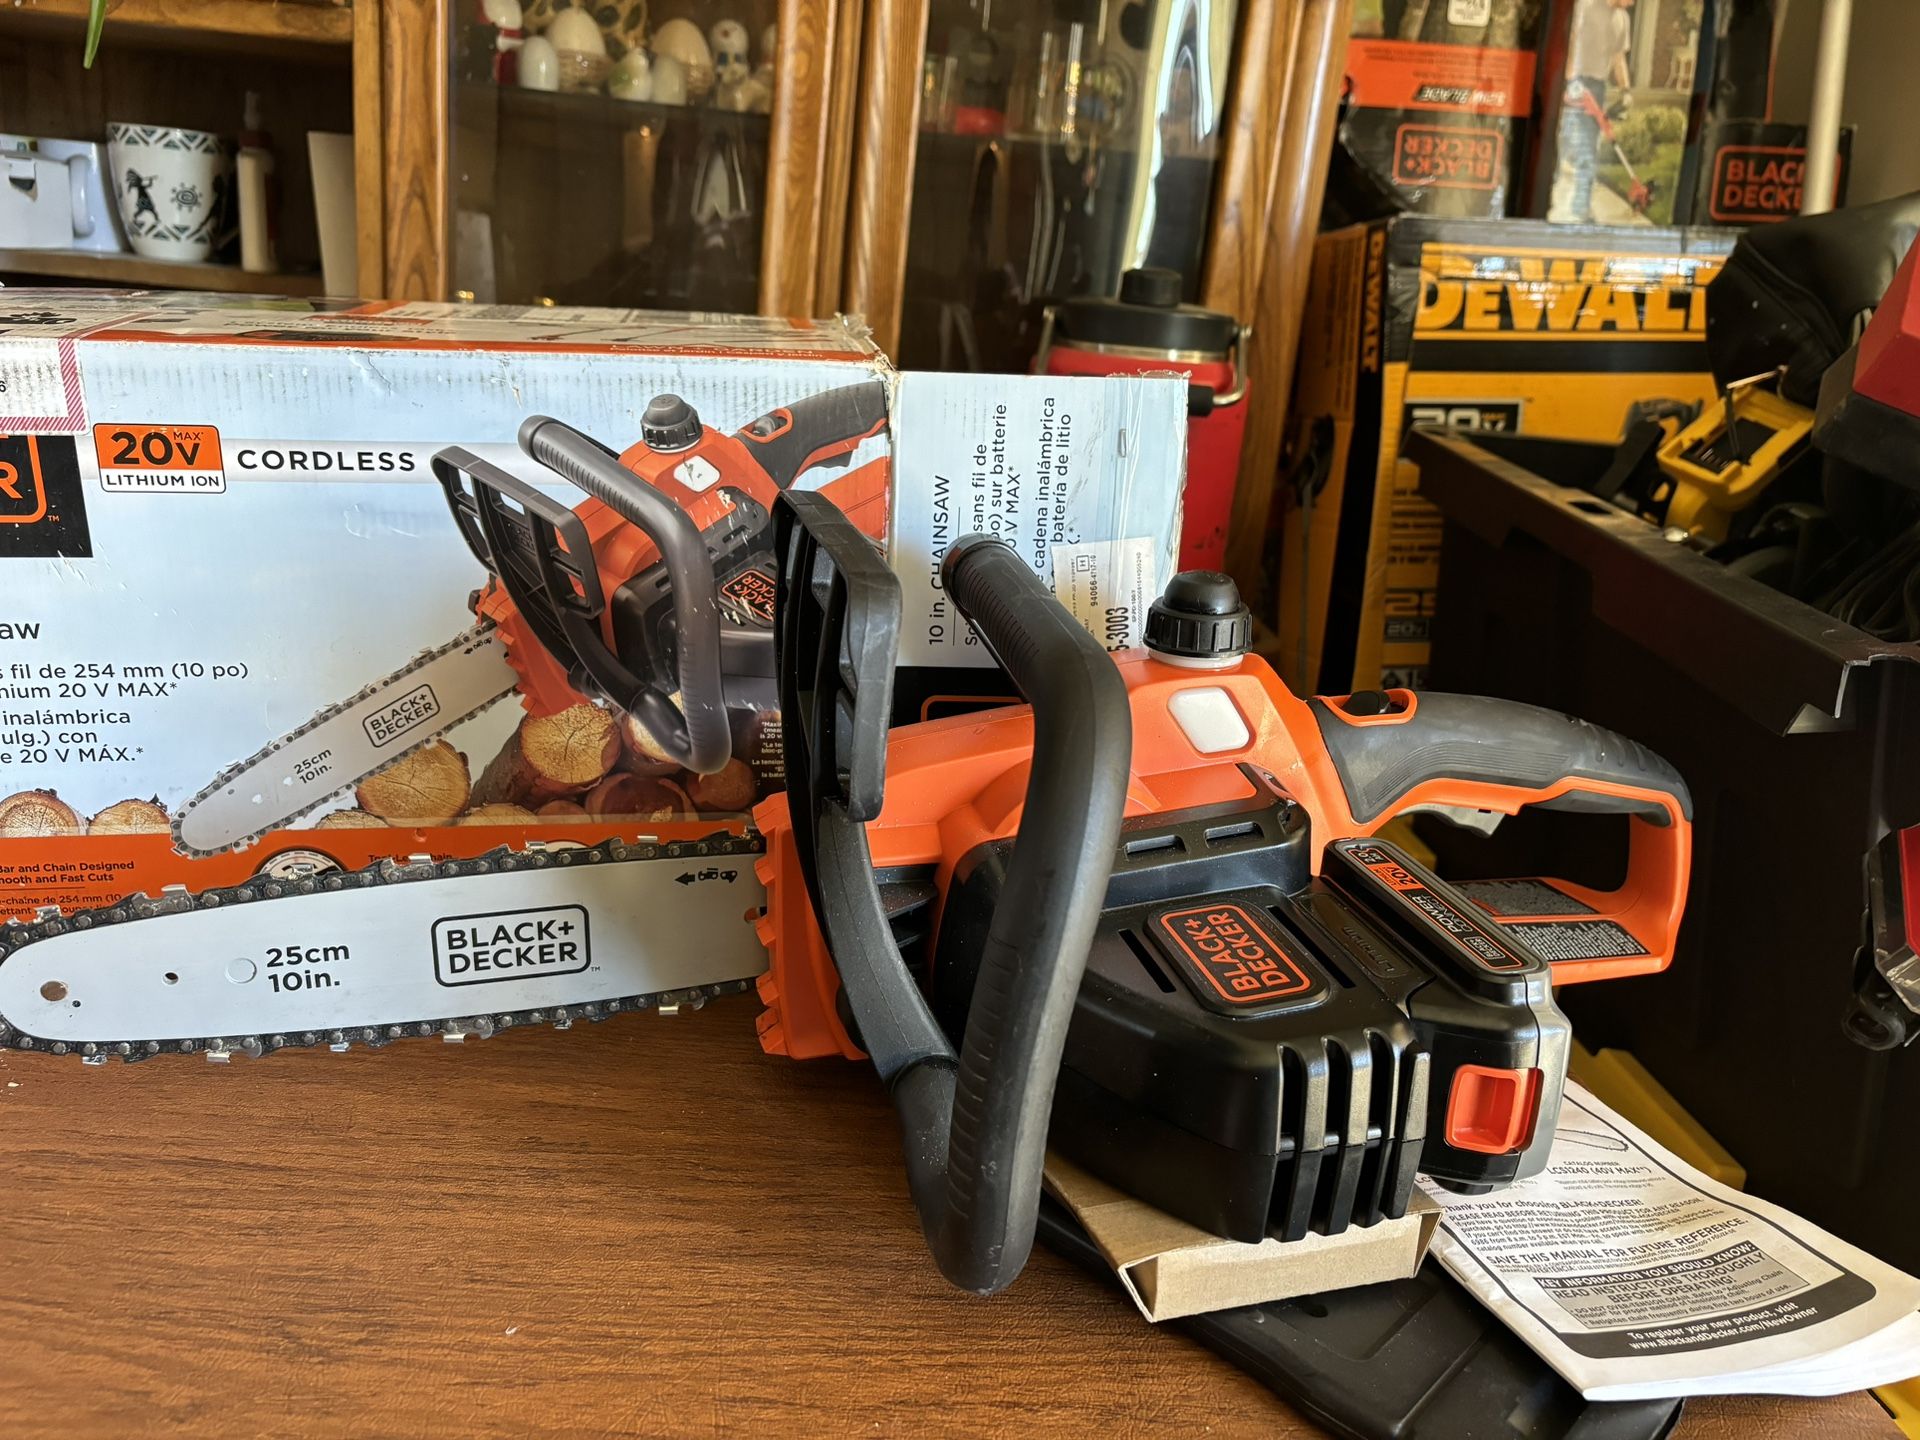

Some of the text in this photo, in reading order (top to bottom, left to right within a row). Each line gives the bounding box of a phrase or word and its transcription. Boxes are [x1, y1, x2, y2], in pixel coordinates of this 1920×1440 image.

[1405, 136, 1492, 157] DECKER
[237, 449, 415, 471] CORDLESS
[990, 404, 1007, 508] sur batterie
[106, 473, 220, 488] LITHIUM ION
[972, 444, 987, 531] sans fil de
[1033, 397, 1055, 569] cadena inalámbrica
[1051, 413, 1072, 543] batería de litio
[1005, 520, 1018, 534] V
[928, 475, 950, 646] 10 in. CHAINSAW
[11, 662, 249, 680] fil de 254 mm (10 po)
[58, 683, 87, 698] 20
[98, 683, 110, 698] V
[3, 709, 131, 726] inalámbrica
[370, 693, 427, 731] BLACK+
[375, 702, 434, 741] DECKER
[58, 732, 98, 744] con
[20, 749, 48, 763] 20
[54, 749, 70, 763] V
[294, 748, 331, 774] 25cm
[299, 765, 332, 784] 10in.
[18, 864, 39, 872] and
[43, 863, 77, 872] Chain
[79, 861, 135, 871] Designed
[36, 872, 114, 883] and Fast Cuts
[59, 895, 80, 903] 254
[82, 894, 103, 903] mm
[1413, 896, 1462, 932] POWER
[1420, 895, 1473, 932] CONNECT
[447, 919, 575, 950] BLACK+
[266, 943, 350, 967] 25cm
[449, 942, 578, 974] DECKER
[1184, 918, 1260, 993] BLACK+
[1215, 911, 1290, 988] DECKER
[267, 969, 341, 993] 10in.
[1448, 1212, 1481, 1221] PLEASE
[1515, 1200, 1560, 1209] choosing
[1559, 1199, 1643, 1208] BLACK+DECKER!
[1486, 1255, 1520, 1263] SAVE
[1519, 1252, 1549, 1262] THIS
[1549, 1249, 1602, 1260] MANUAL
[1601, 1248, 1628, 1256] FOR
[1627, 1240, 1676, 1254] FUTURE
[1675, 1218, 1747, 1245] REFERENCE.
[1537, 1279, 1561, 1287] KEY
[1562, 1272, 1642, 1286] INFORMATION
[1641, 1267, 1668, 1277] YOU
[1668, 1258, 1713, 1272] SHOULD
[1713, 1244, 1754, 1262] KNOW:
[1552, 1288, 1589, 1298] READ
[1590, 1276, 1682, 1294] INSTRUCTIONS
[1681, 1252, 1764, 1281] THOROUGHLY
[1760, 1270, 1783, 1280] Chain
[1607, 1275, 1736, 1302] BEFORE OPERATING!
[1648, 1308, 1688, 1318] frequently
[1688, 1304, 1714, 1312] during
[1742, 1292, 1766, 1301] hours
[1630, 1306, 1818, 1349] www.BlackandDecker.com/NewOwner
[1644, 1328, 1684, 1337] register
[1684, 1323, 1709, 1333] your
[1709, 1320, 1731, 1328] new
[1732, 1310, 1776, 1324] product,
[1774, 1302, 1798, 1313] visit
